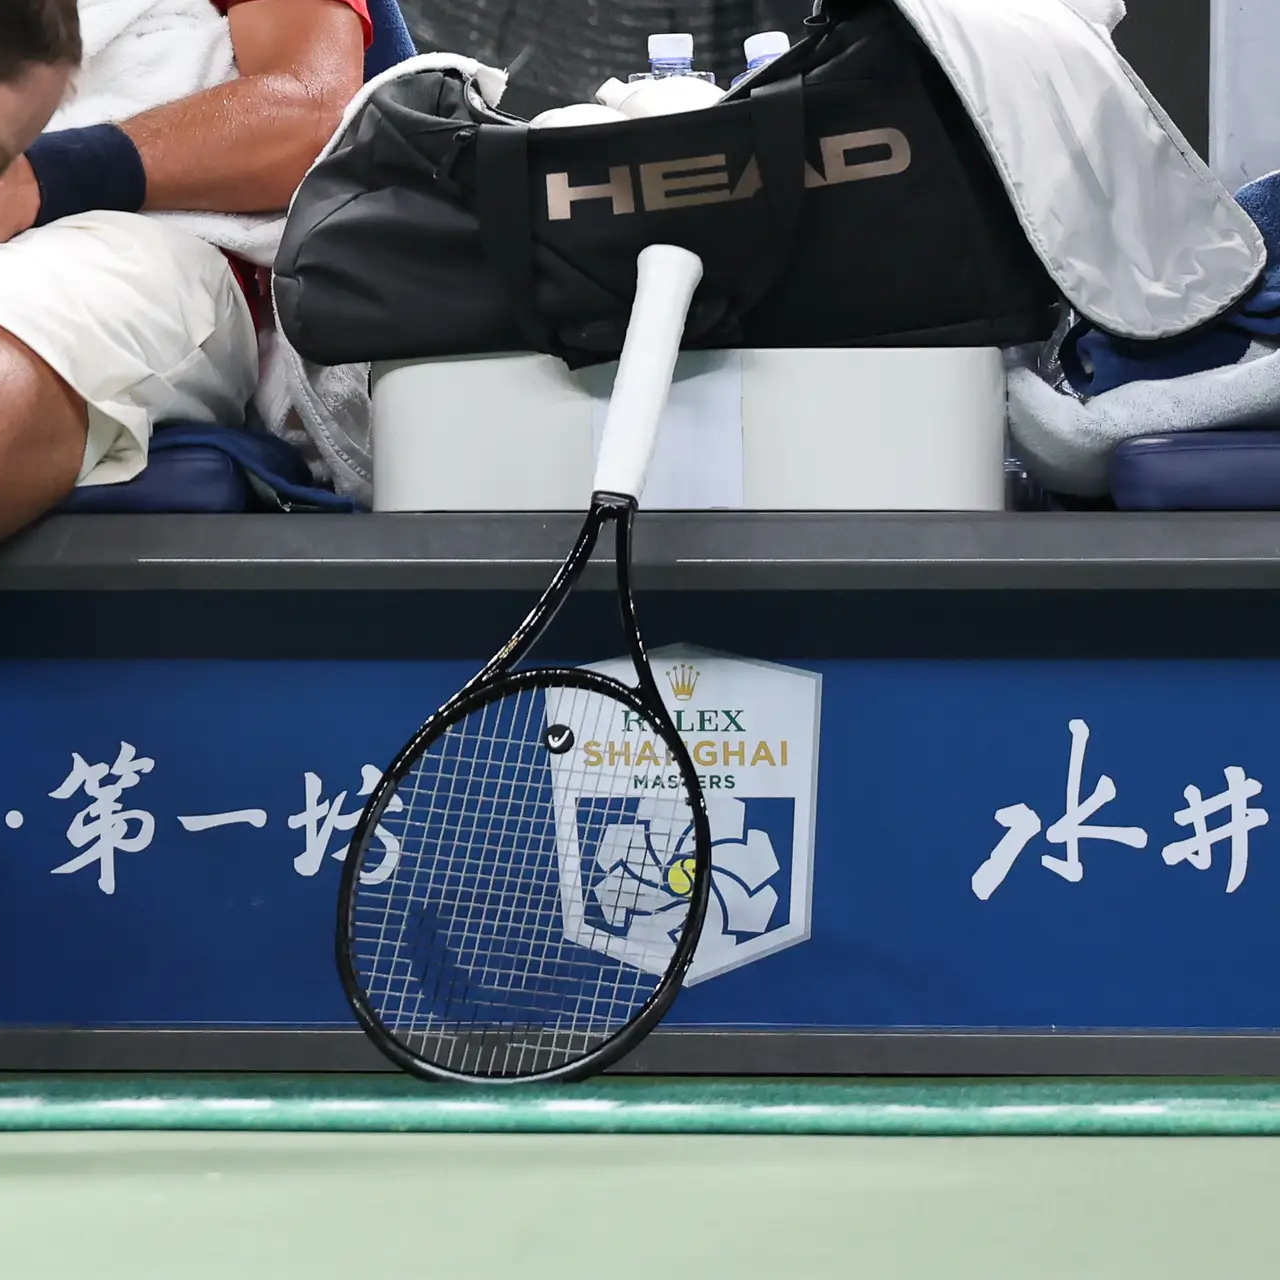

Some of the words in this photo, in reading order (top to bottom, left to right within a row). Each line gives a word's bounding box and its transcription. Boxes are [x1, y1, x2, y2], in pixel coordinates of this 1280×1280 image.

[621, 709, 747, 732] RLEX
[633, 775, 736, 790] MASERS
[971, 718, 1270, 901] 水井
